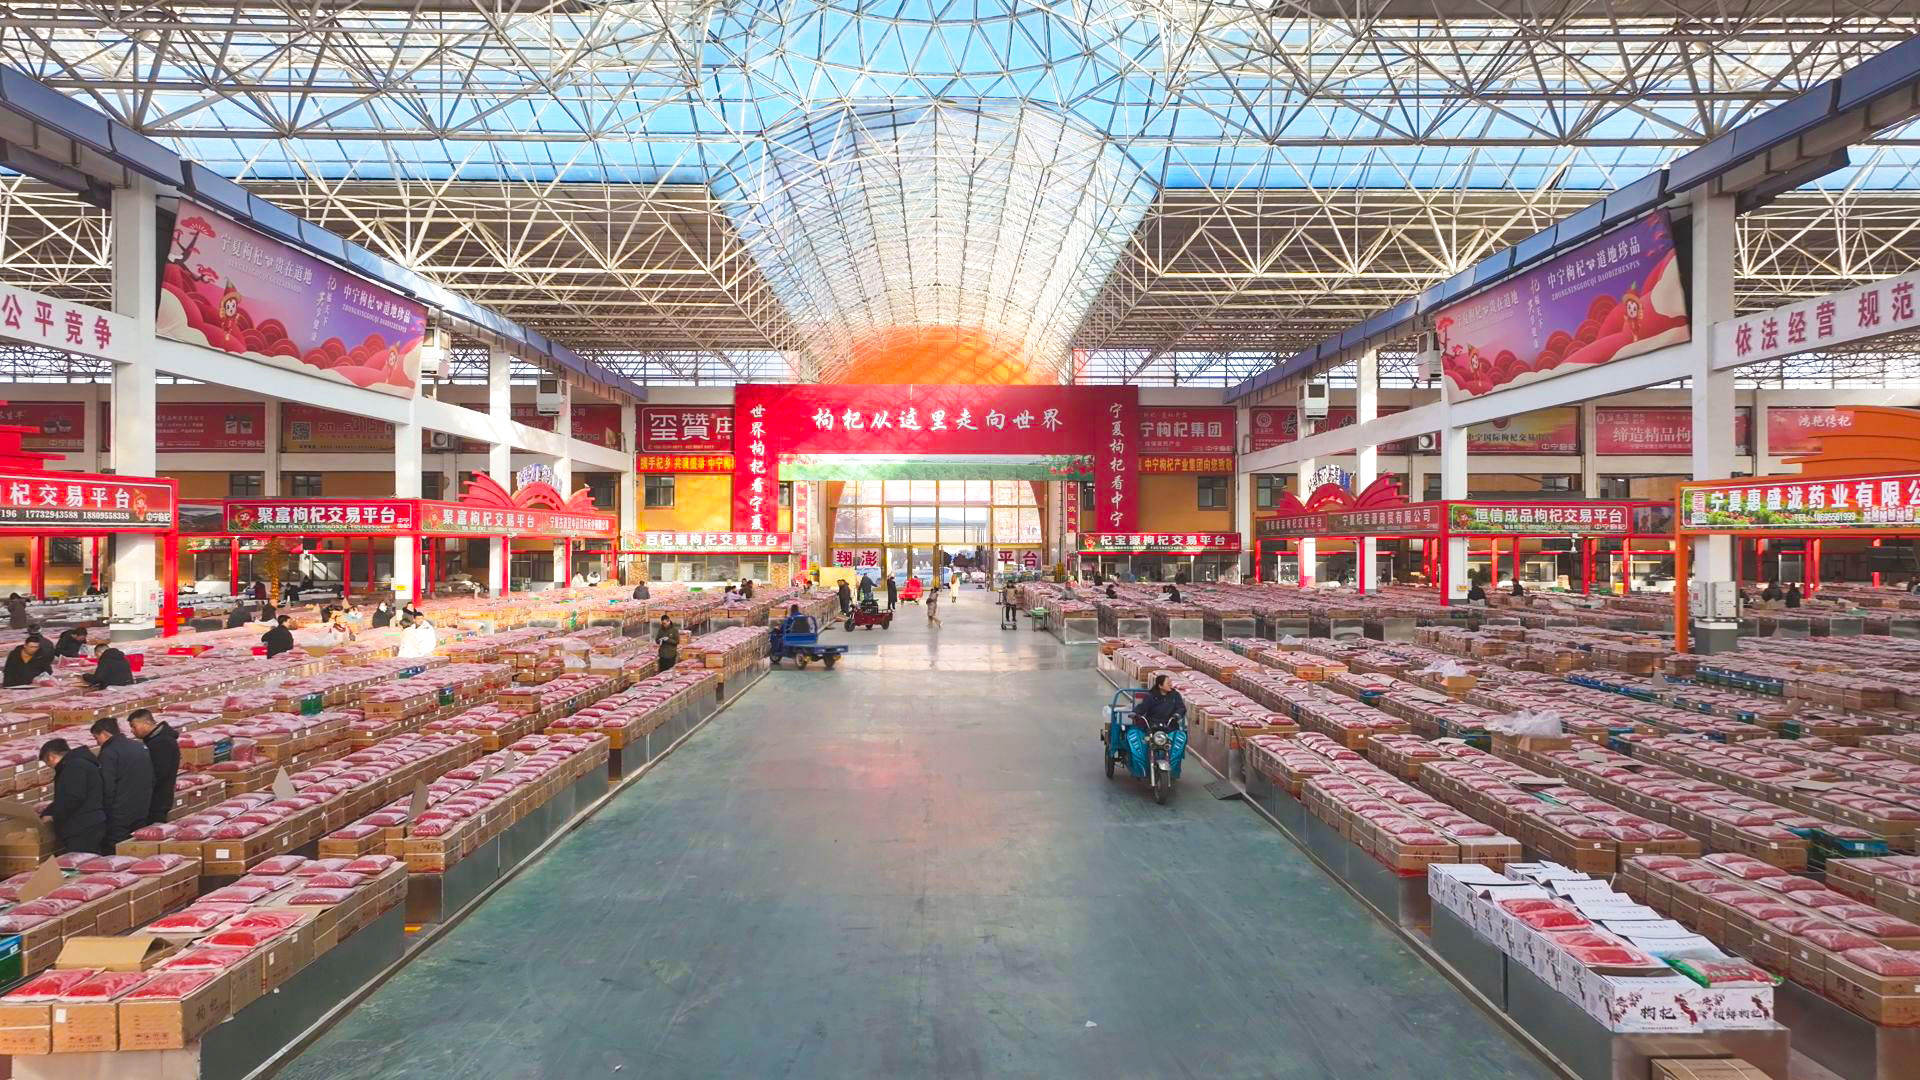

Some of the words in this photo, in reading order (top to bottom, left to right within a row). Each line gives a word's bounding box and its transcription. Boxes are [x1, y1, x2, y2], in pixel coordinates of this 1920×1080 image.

[1547, 260, 1587, 290] 中宁枸杞
[1597, 235, 1641, 269] 道地珍品
[343, 283, 377, 311] 中宁枸杞
[382, 300, 412, 325] 道地珍品
[2, 294, 112, 350] 公平竞争
[1734, 301, 1837, 357] 依法经营
[1857, 280, 1916, 328] 规范
[812, 407, 1063, 432] 枸杞从这里走向世界
[749, 403, 767, 531] 世界枸杞看宁夏
[1109, 402, 1126, 527] 宁夏枸杞看中宁
[0, 482, 130, 509] 杞交易平台
[257, 506, 396, 524] 聚富枸杞交易平台
[442, 508, 536, 528] 聚富枸杞交易平台
[1474, 508, 1623, 524] 恒信成品枸杞交易平台
[1099, 534, 1226, 547] 杞宝源枸杞交易平台
[836, 550, 877, 567] 翔澎
[997, 550, 1038, 567] 平台
[1640, 1005, 1677, 1021] 枸杞
